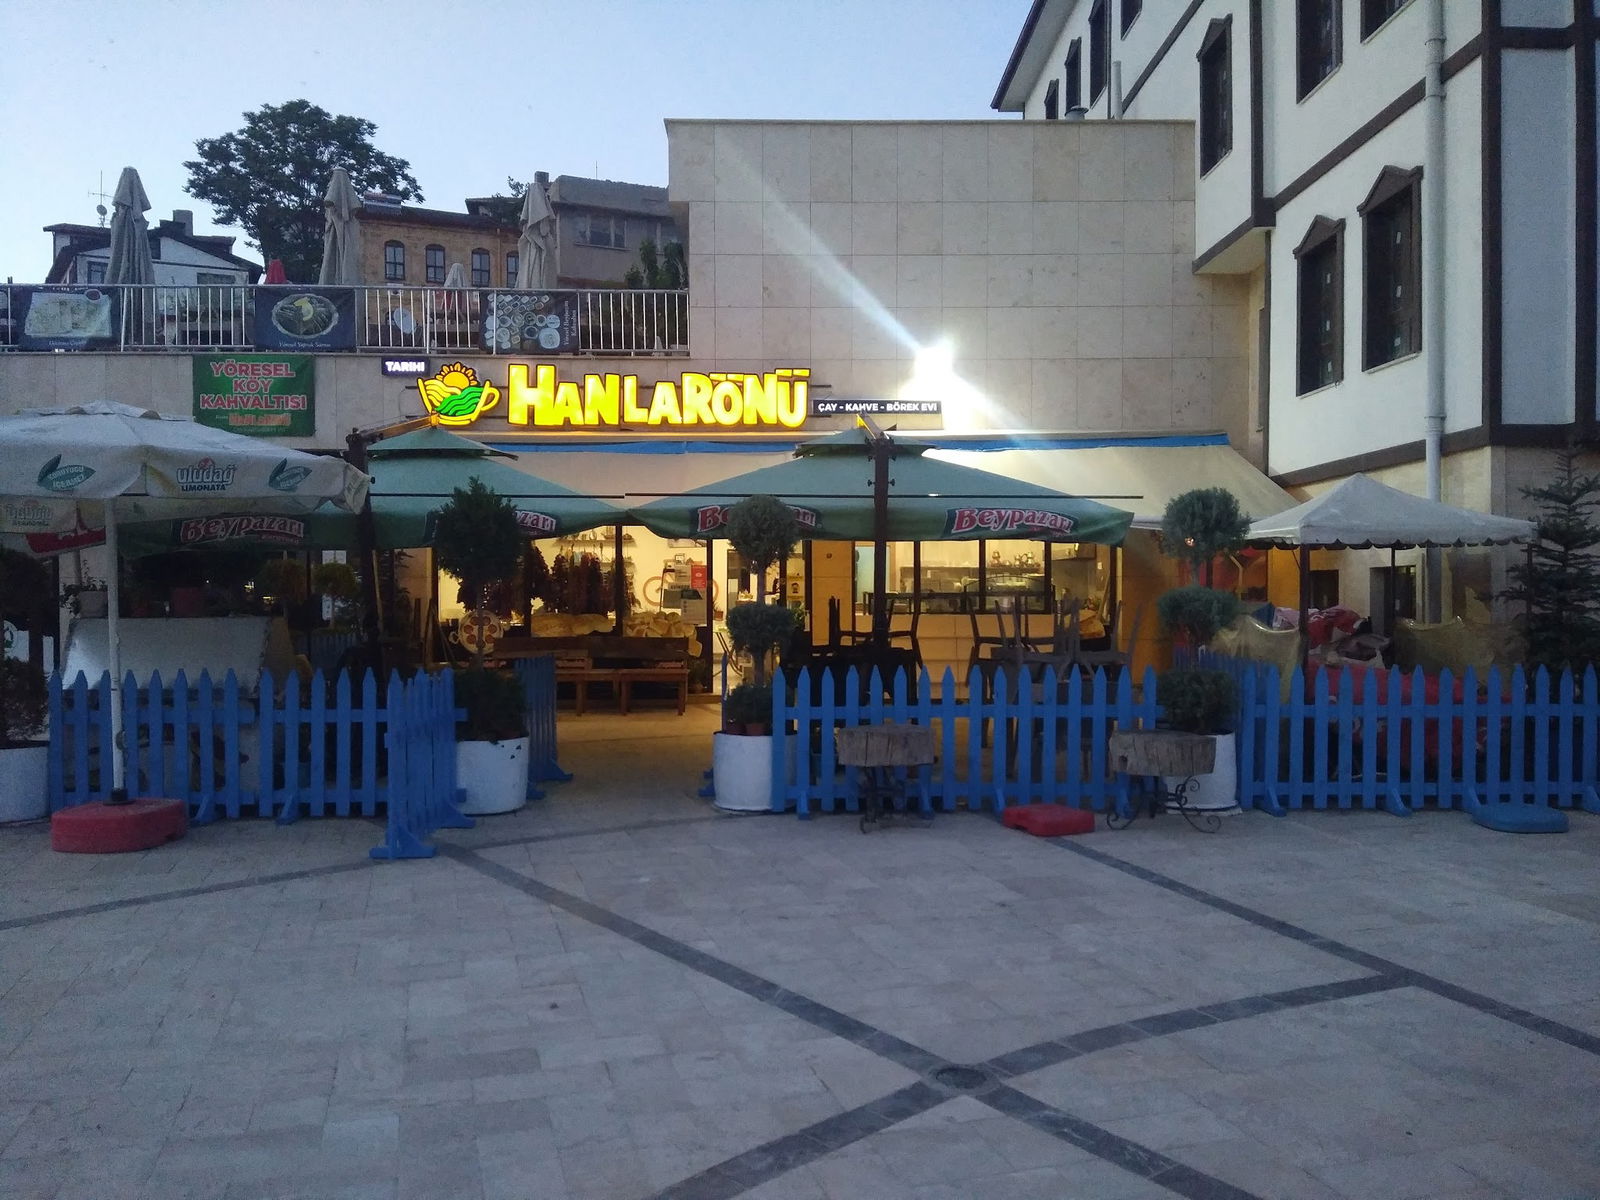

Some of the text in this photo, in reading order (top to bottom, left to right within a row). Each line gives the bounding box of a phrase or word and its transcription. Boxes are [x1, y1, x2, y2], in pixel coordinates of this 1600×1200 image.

[210, 359, 296, 377] YÖRESEL
[232, 376, 274, 393] KÖY
[200, 394, 307, 409] KAHVALTISI
[508, 364, 810, 428] HANLARÖNÜ
[818, 402, 838, 412] ÇAY
[845, 403, 879, 411] KAHVE
[886, 402, 919, 411] BÖREK
[181, 516, 304, 543] Beypazarı
[952, 508, 1074, 534] Beypazarı
